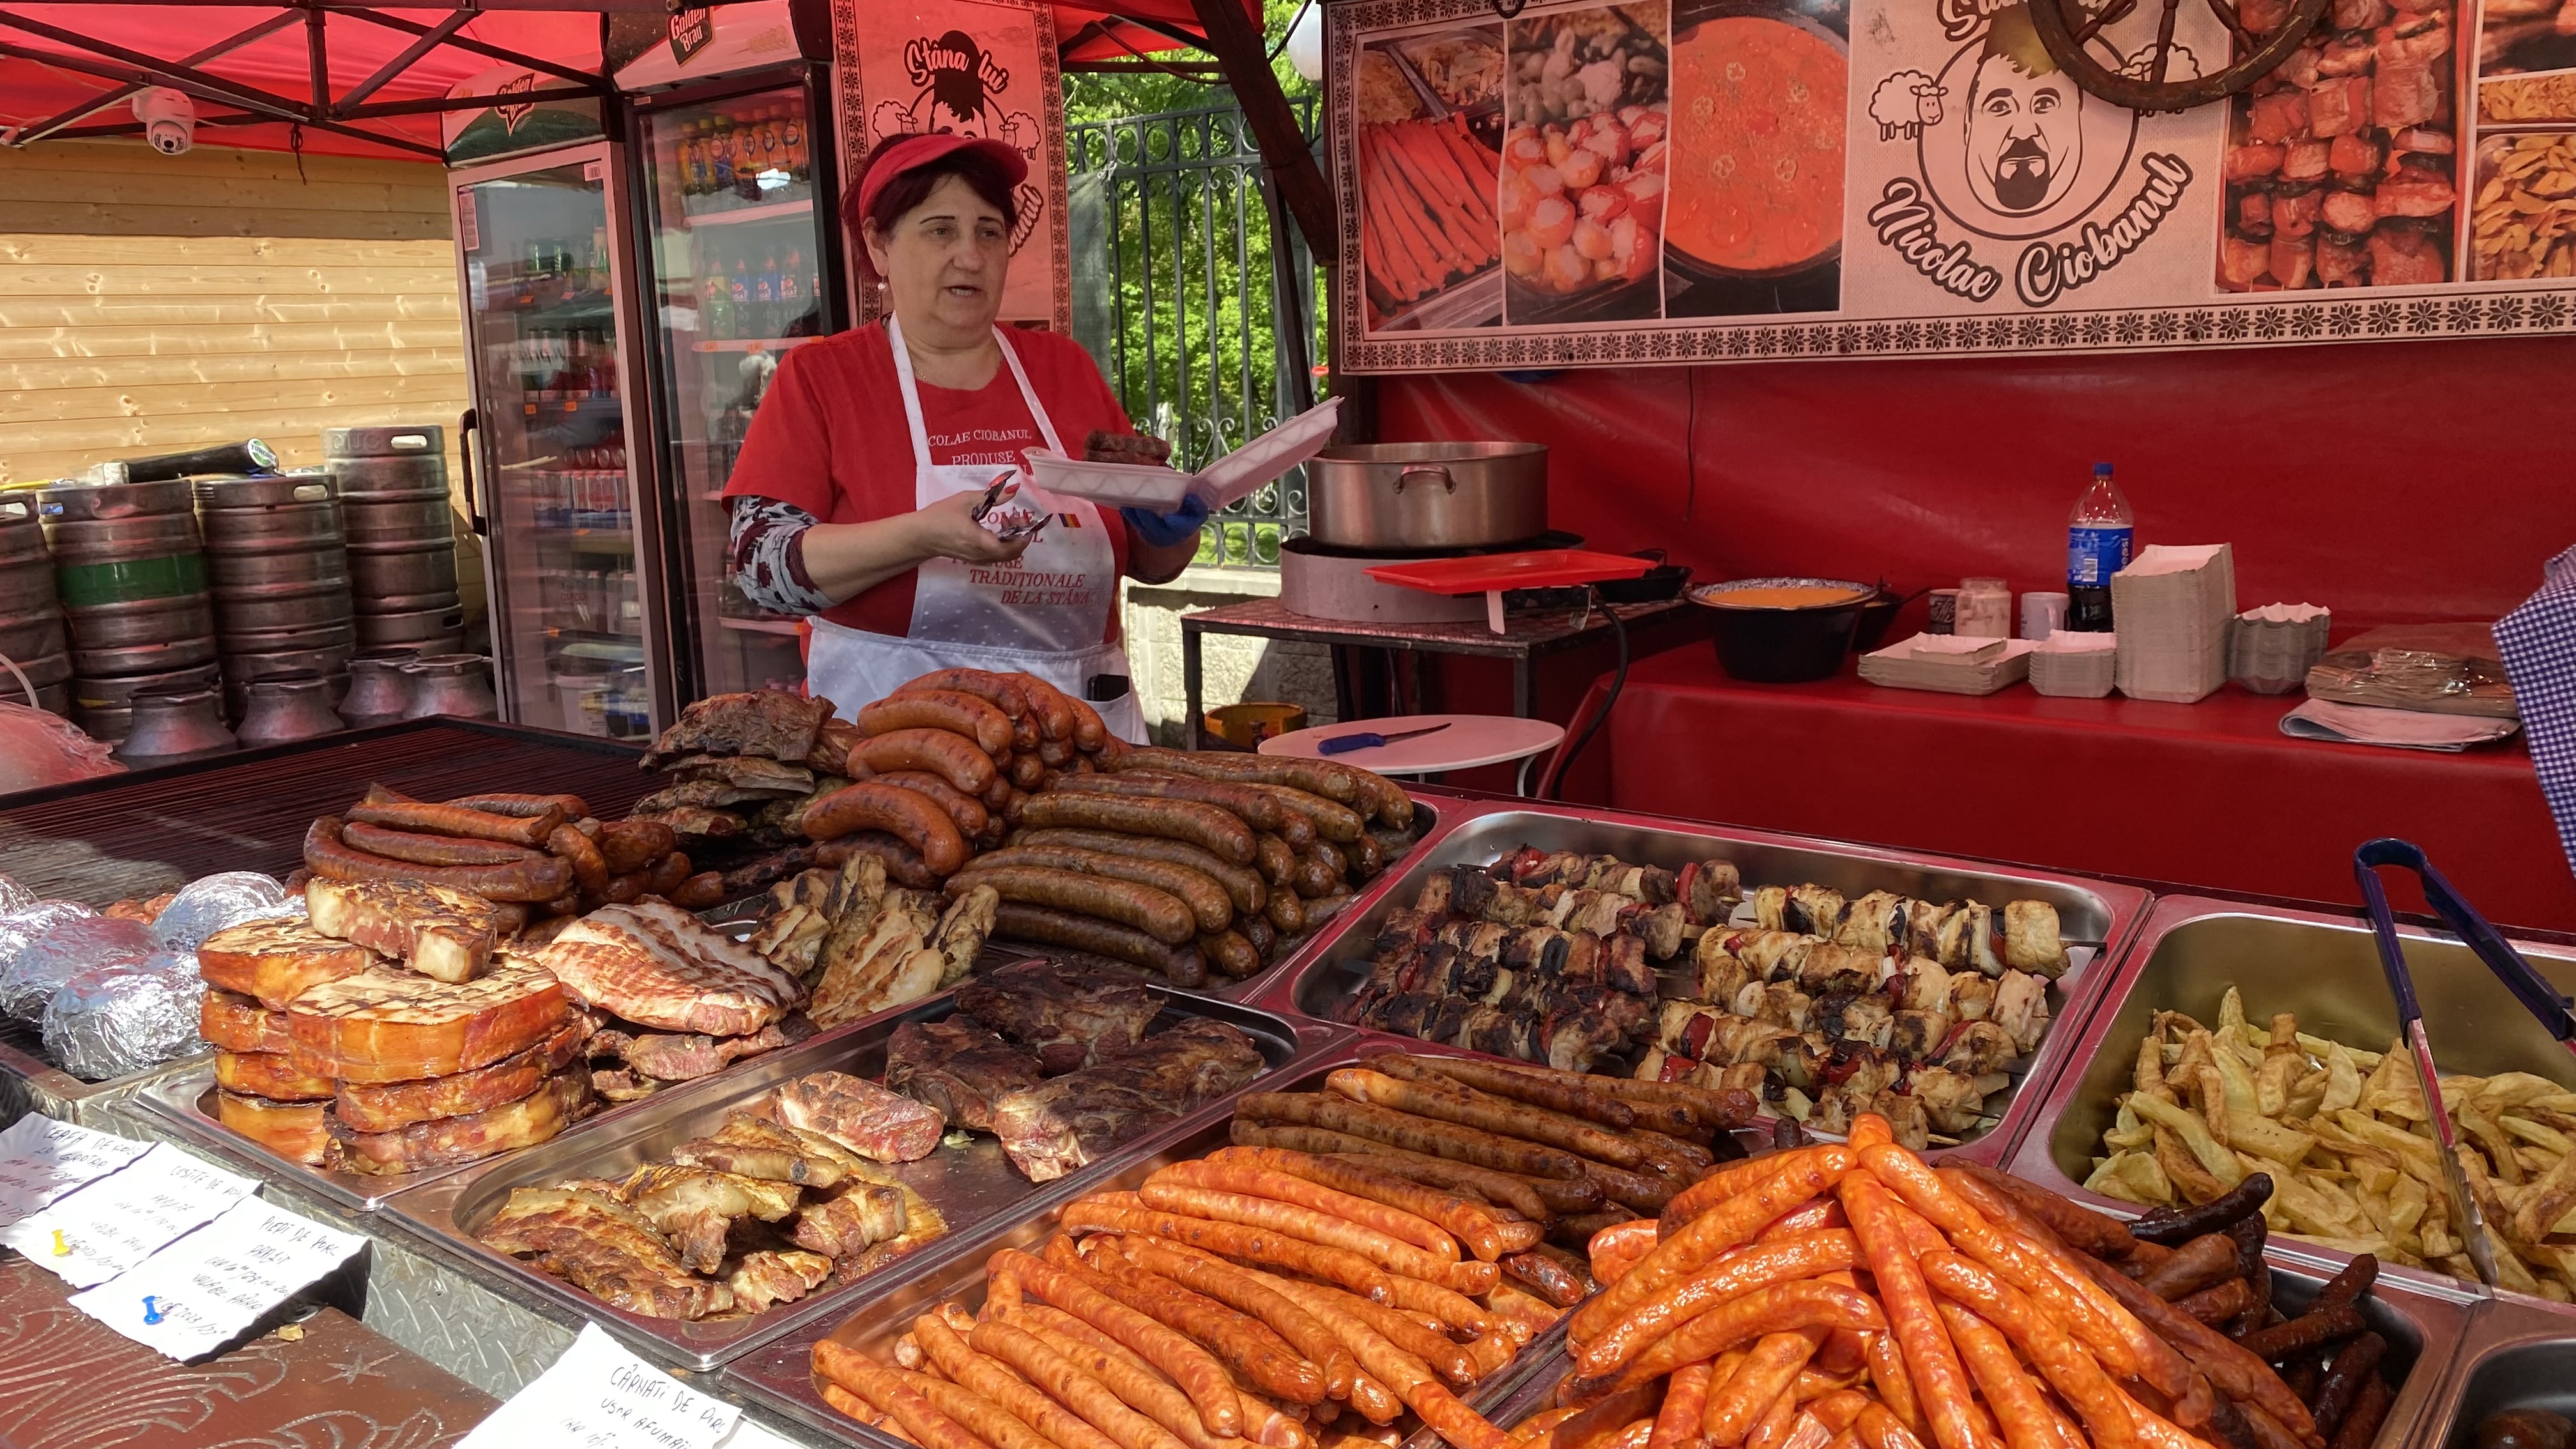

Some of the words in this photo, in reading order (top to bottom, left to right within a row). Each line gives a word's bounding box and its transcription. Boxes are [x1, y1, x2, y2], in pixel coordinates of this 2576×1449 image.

[905, 38, 970, 86] Stâna
[978, 50, 1009, 93] lui
[1869, 178, 2002, 301] Nicolae
[2016, 152, 2193, 306] Ciobanul
[928, 431, 970, 447] COLAE
[973, 429, 1032, 441] CIOBANUL
[250, 443, 275, 463] TUBORG
[951, 450, 1015, 466] PRODUSE
[1000, 590, 1022, 604] DE
[1022, 590, 1043, 604] LA
[43, 1127, 88, 1142] CEAFA
[91, 1138, 114, 1150] DE
[208, 1179, 224, 1190] DE
[288, 1227, 312, 1243] DE
[671, 1390, 695, 1413] DE
